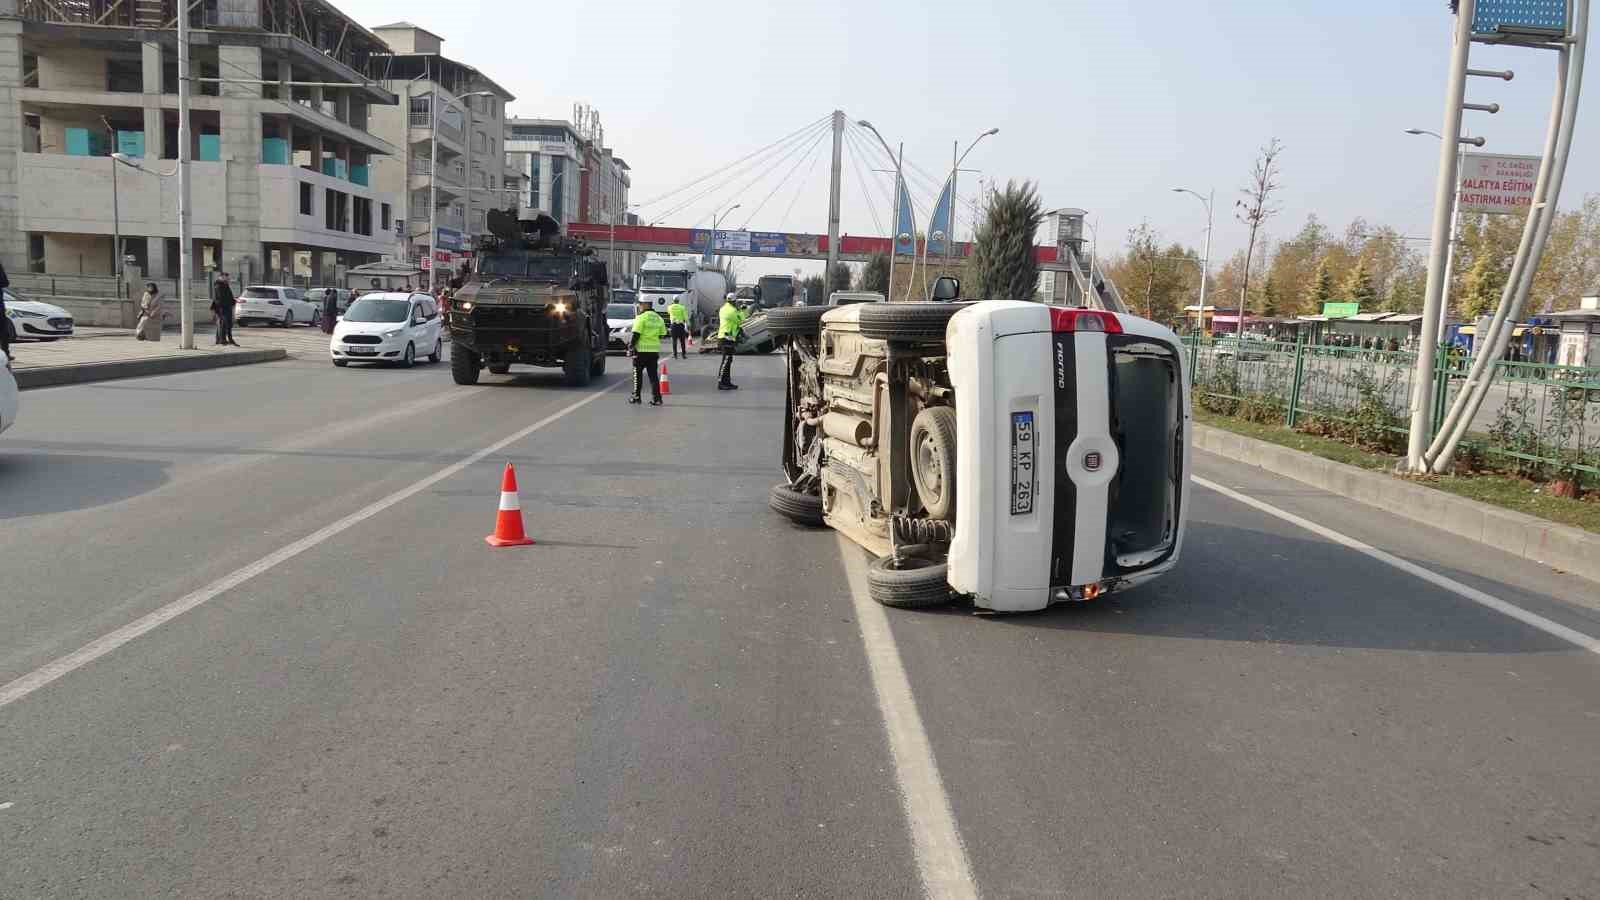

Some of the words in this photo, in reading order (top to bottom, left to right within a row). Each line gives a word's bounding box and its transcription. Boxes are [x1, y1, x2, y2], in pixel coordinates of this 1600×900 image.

[1018, 422, 1031, 441] 59
[1019, 452, 1031, 471] KP
[1017, 481, 1031, 510] 263
